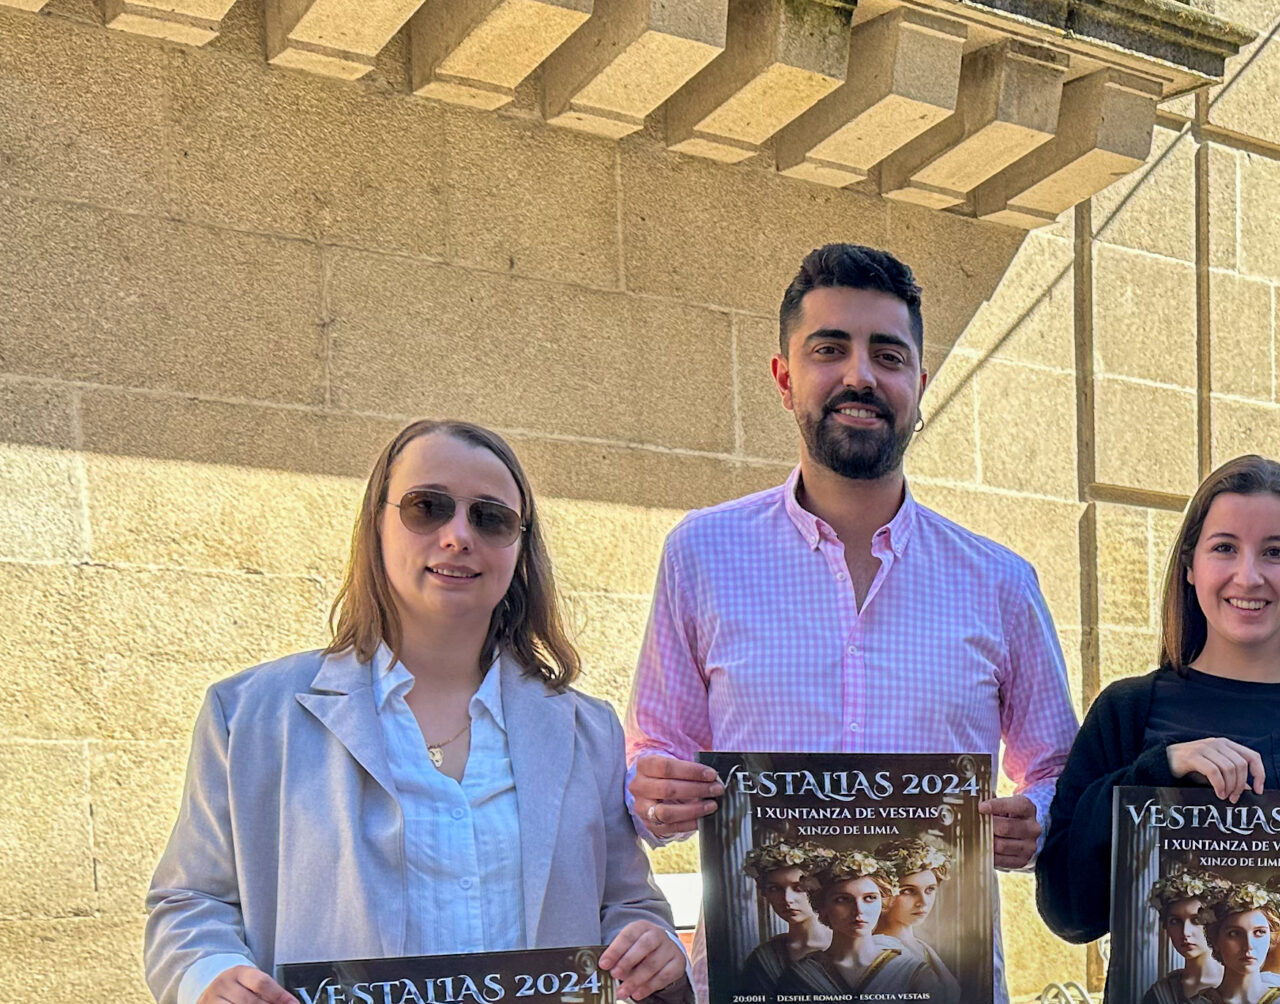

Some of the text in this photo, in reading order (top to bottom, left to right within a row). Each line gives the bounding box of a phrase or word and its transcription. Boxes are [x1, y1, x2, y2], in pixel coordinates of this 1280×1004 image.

[902, 772, 980, 797] 2024
[756, 807, 936, 818] I XUNTANZA DE VESTAIS
[798, 825, 898, 834] XINZO DE LIMIA
[1164, 839, 1168, 849] I
[1172, 839, 1247, 851] XUNTANZA
[1251, 840, 1269, 851] DE
[1199, 857, 1237, 866] XINZO
[1239, 857, 1254, 866] DE
[515, 969, 602, 999] 2024
